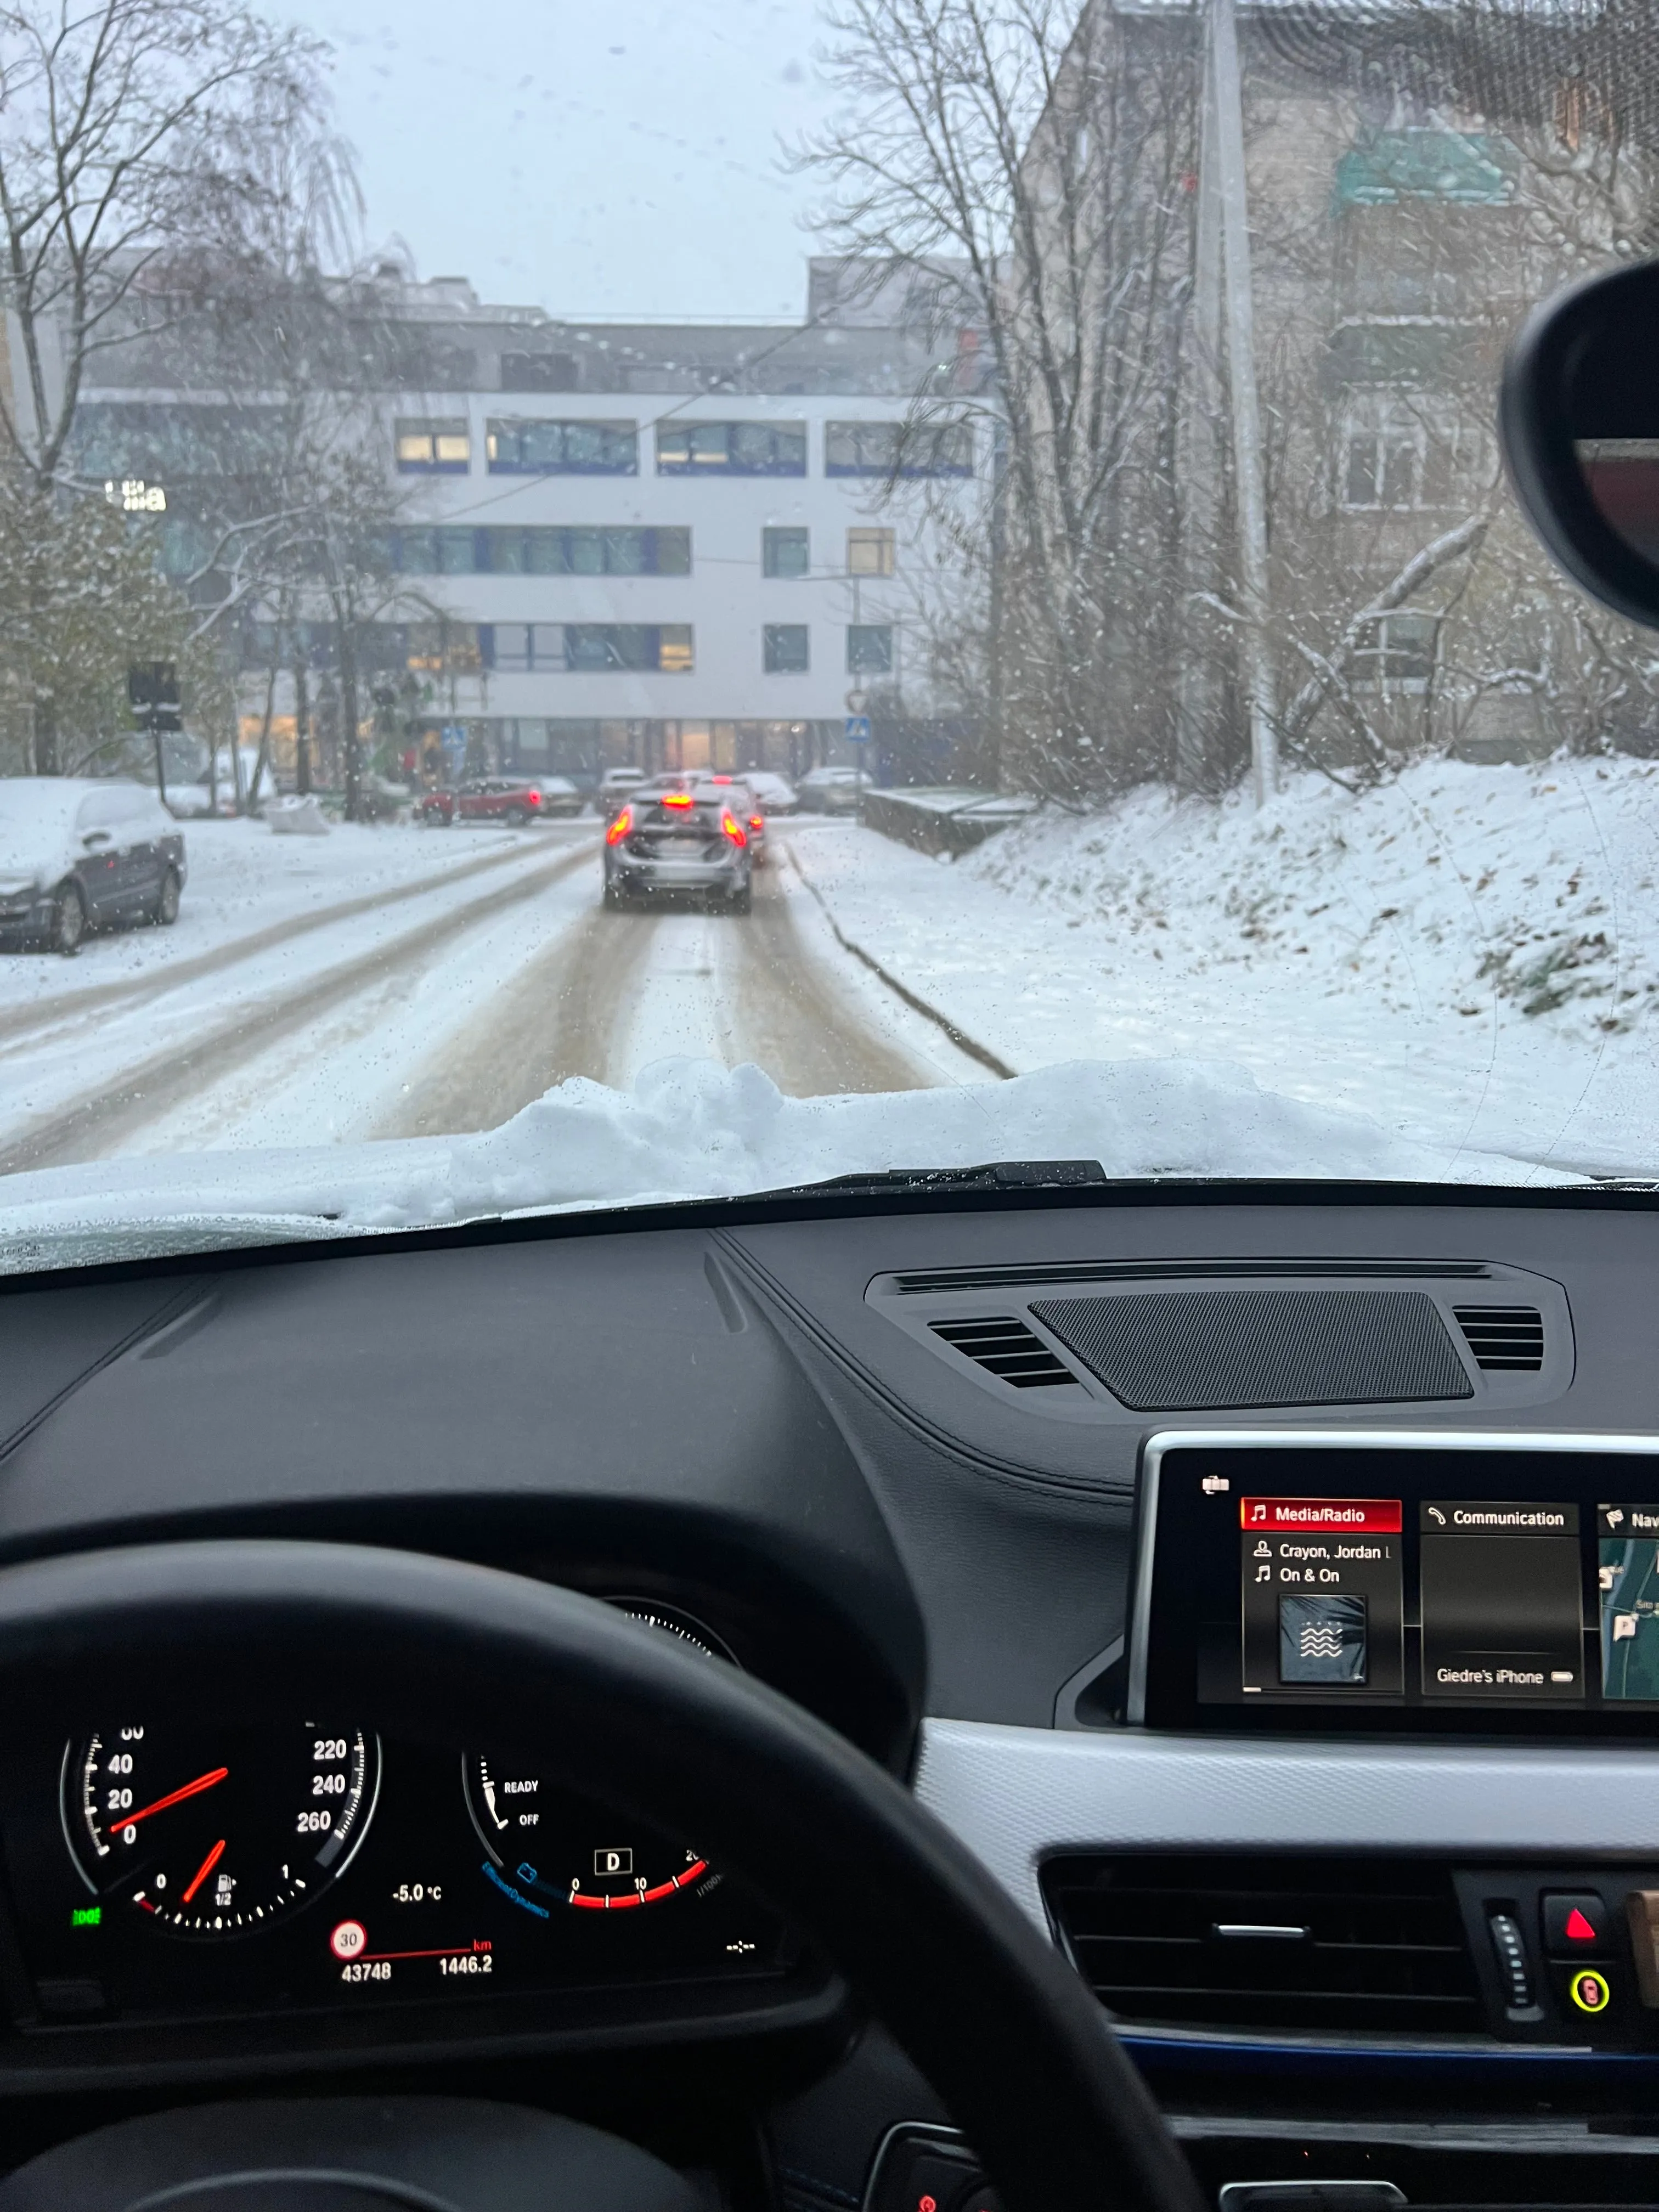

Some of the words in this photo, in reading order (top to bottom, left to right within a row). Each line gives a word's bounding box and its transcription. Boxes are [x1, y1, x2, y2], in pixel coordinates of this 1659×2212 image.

[1276, 1508, 1365, 1522] Media/Radio
[1453, 1510, 1564, 1526] Communication
[1279, 1544, 1330, 1560] Crayon,
[1334, 1545, 1381, 1559] Jordan
[1280, 1568, 1301, 1582] On
[1305, 1568, 1315, 1582] &
[1319, 1568, 1340, 1582] On
[1437, 1668, 1493, 1683] Giedre's
[1496, 1669, 1544, 1684] iPhone
[313, 1739, 347, 1760] 220
[108, 1754, 133, 1774] 40
[312, 1774, 346, 1795] 240
[504, 1780, 538, 1793] READY
[108, 1788, 133, 1809] 20
[297, 1810, 331, 1832] 260
[519, 1814, 539, 1826] OFF
[124, 1824, 136, 1844] 0
[607, 1853, 620, 1871] D
[282, 1864, 289, 1879] 1
[156, 1873, 167, 1889] 0
[572, 1878, 580, 1891] 0
[634, 1877, 647, 1890] 10
[215, 1892, 232, 1906] 1/2
[393, 1884, 424, 1902] -5.0
[427, 1886, 442, 1900] °C
[340, 1933, 358, 1947] 30
[473, 1939, 492, 1951] km
[342, 1962, 392, 1983] 43748
[439, 1955, 493, 1976] 1446.2
